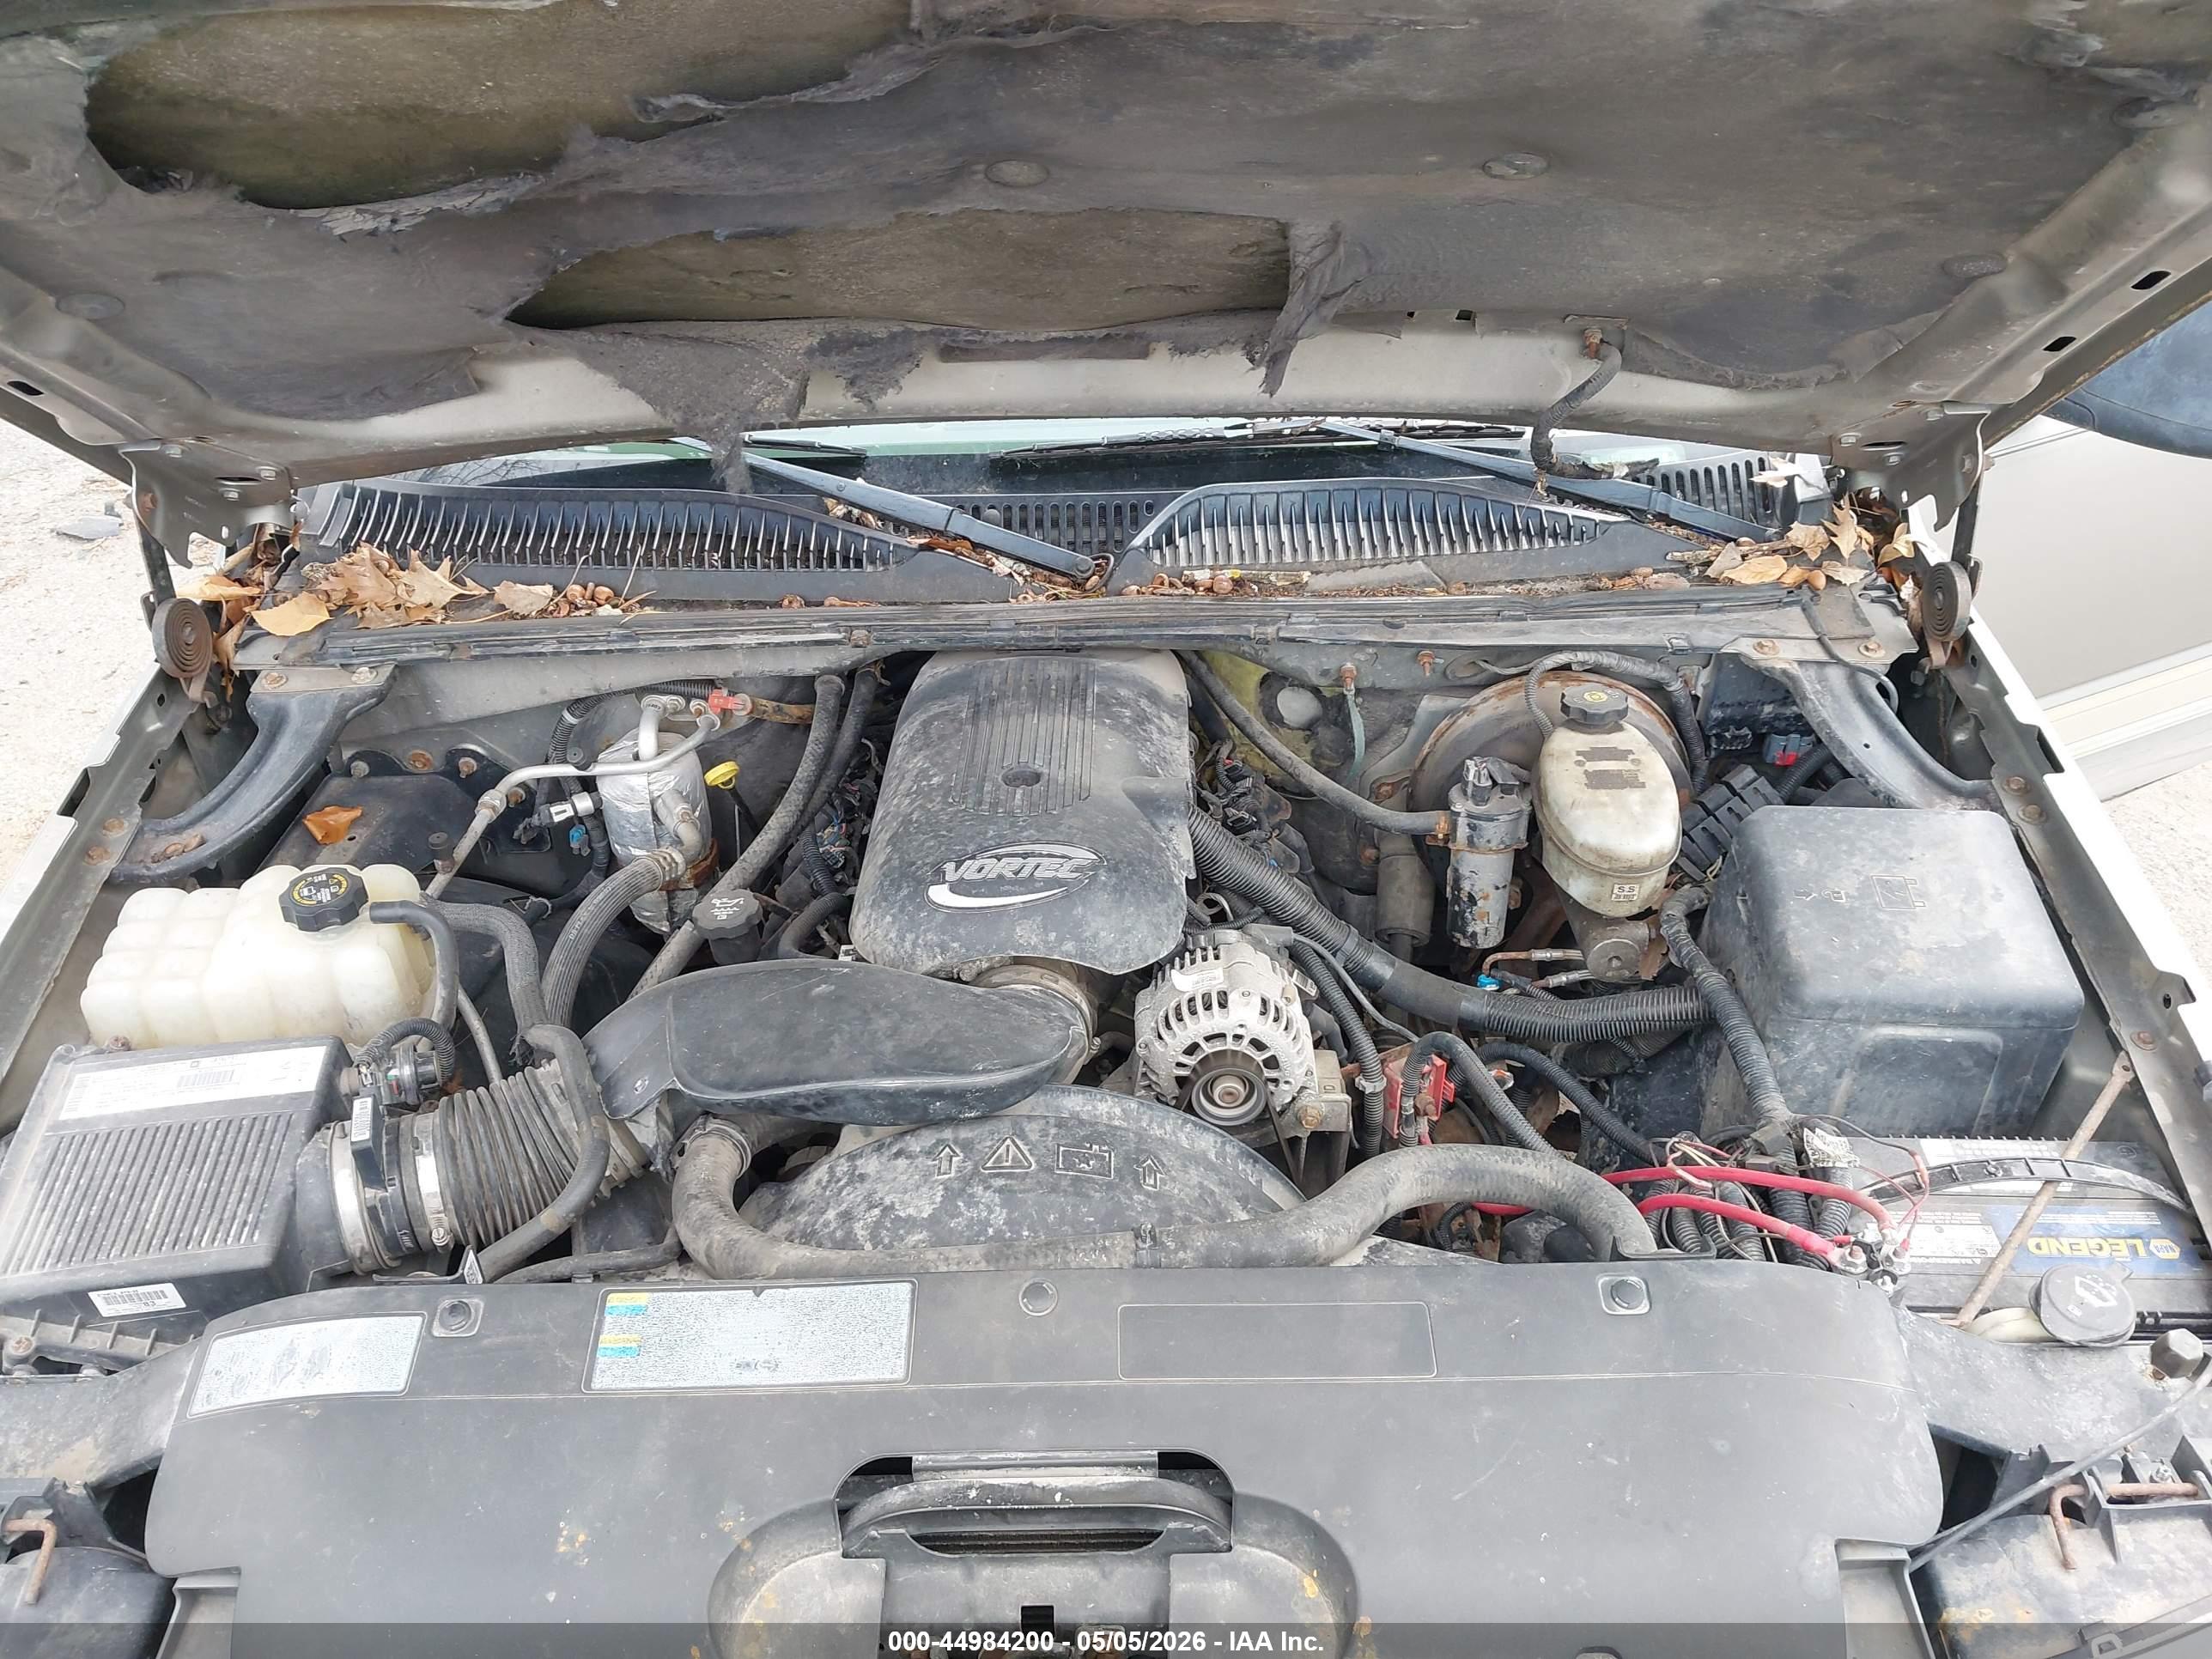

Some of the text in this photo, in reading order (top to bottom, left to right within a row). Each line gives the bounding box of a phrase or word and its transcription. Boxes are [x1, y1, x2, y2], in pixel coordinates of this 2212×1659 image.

[942, 857, 1096, 883] VORTEC
[2027, 1237, 2176, 1259] NAPA LEGEND
